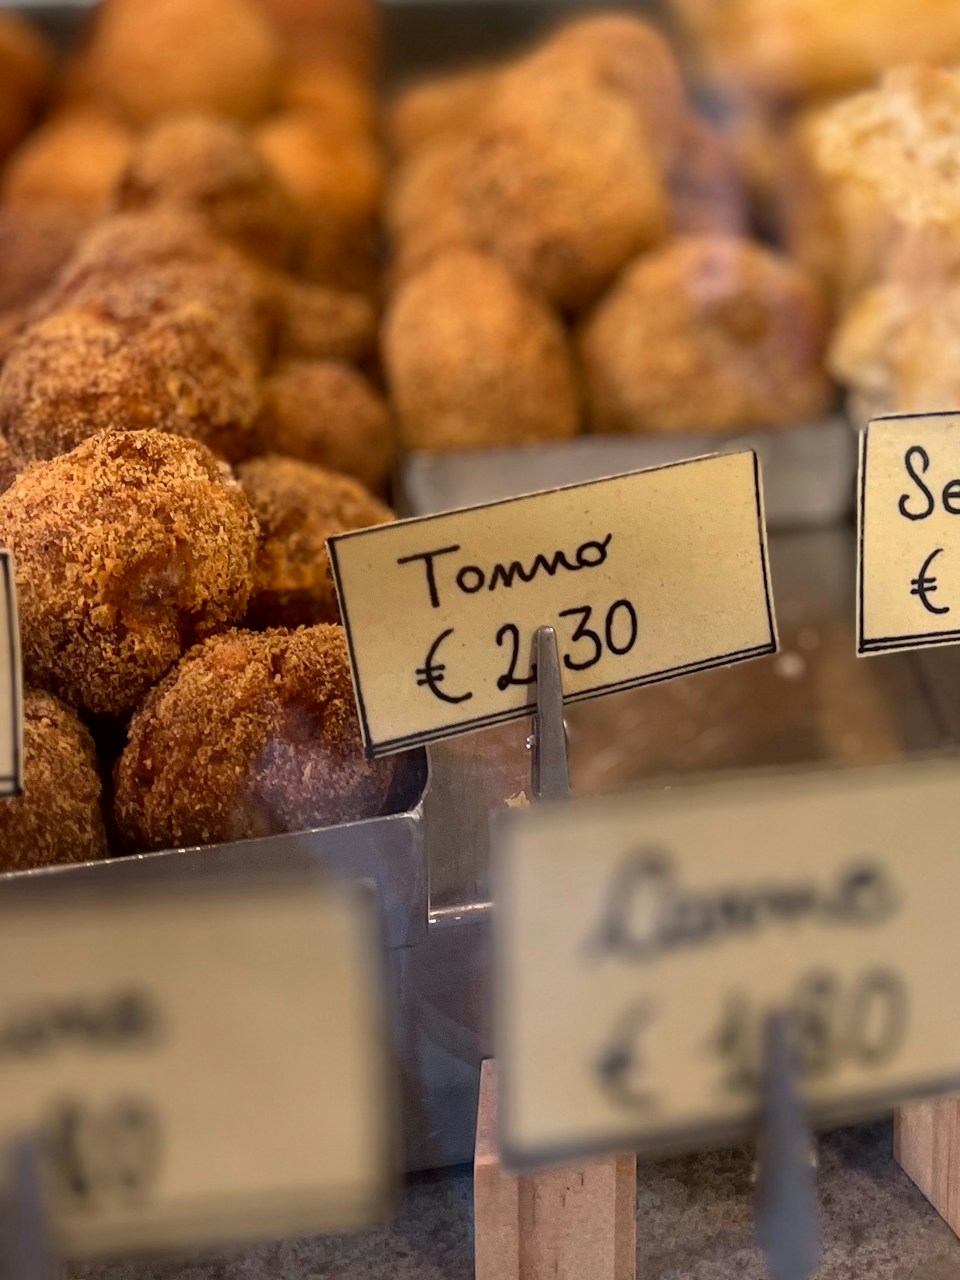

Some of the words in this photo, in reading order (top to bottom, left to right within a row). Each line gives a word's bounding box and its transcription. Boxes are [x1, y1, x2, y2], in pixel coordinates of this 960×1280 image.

[396, 532, 613, 609] Tonno
[910, 548, 950, 615] €
[415, 628, 473, 704] €
